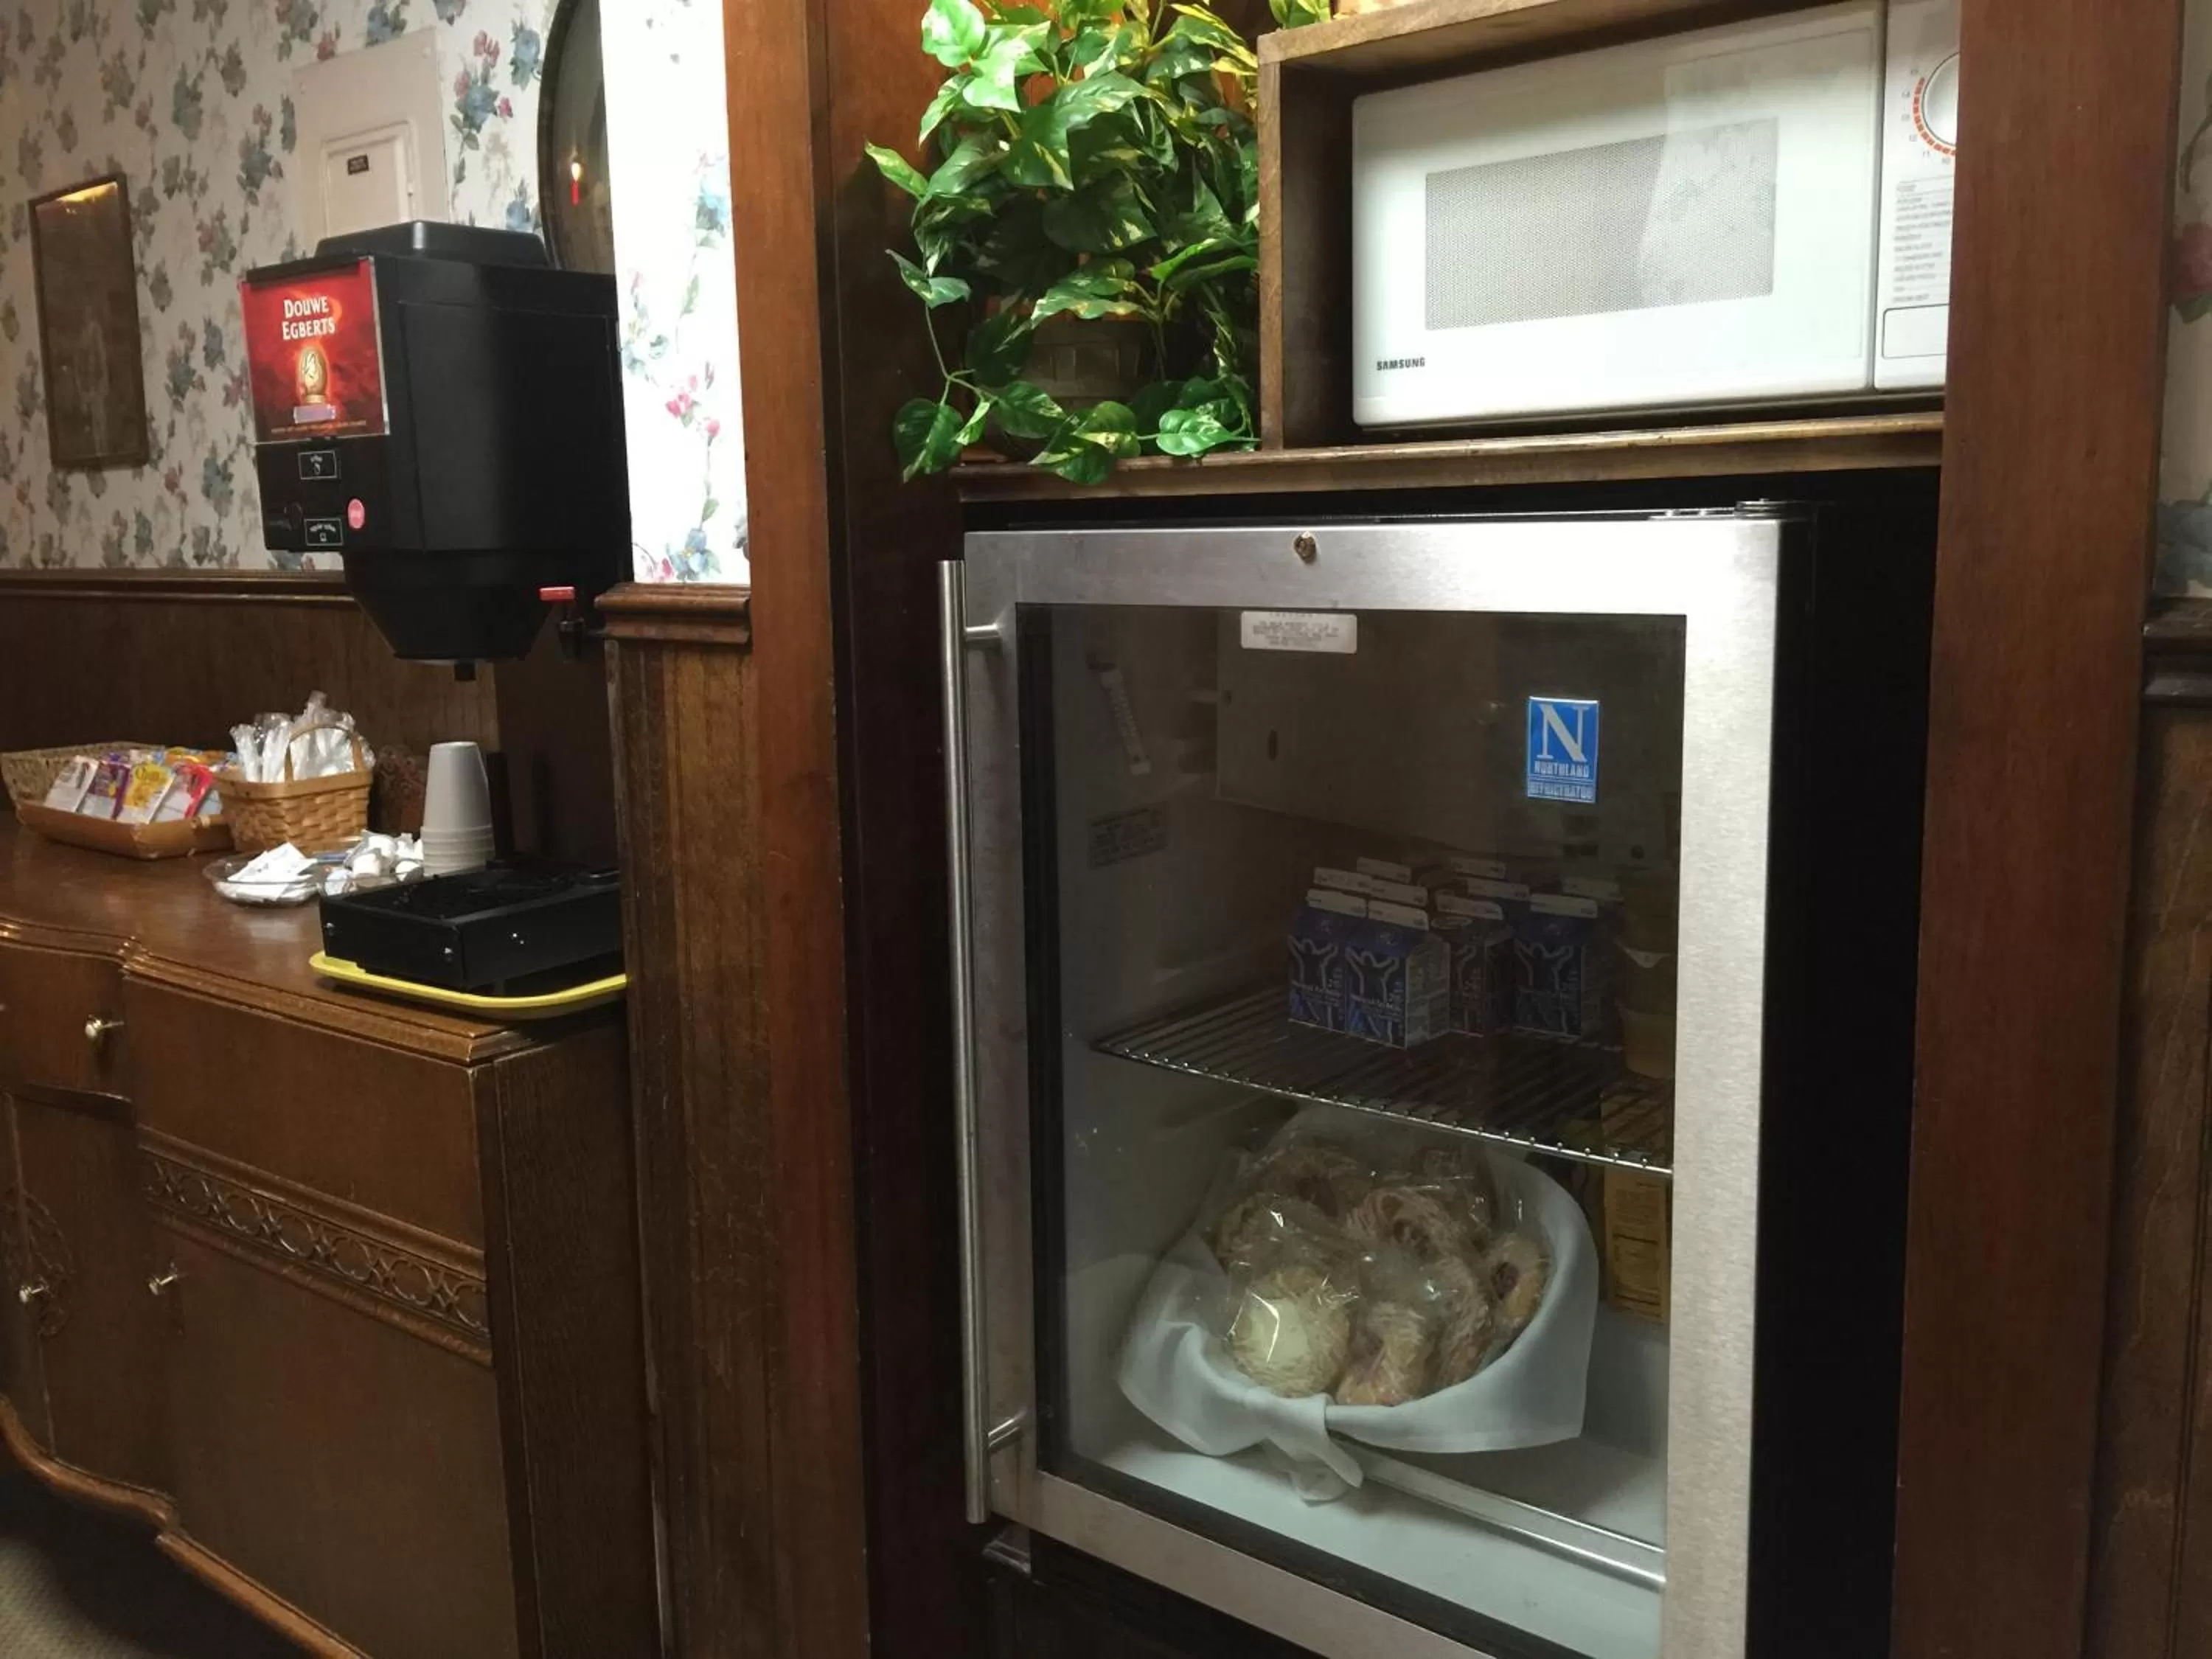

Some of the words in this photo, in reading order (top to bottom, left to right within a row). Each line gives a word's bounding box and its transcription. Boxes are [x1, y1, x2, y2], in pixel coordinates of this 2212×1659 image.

[283, 296, 330, 319] DOUWE
[282, 317, 335, 340] EGBERTS
[1377, 357, 1425, 371] SAMSUNG
[1537, 703, 1589, 762] N
